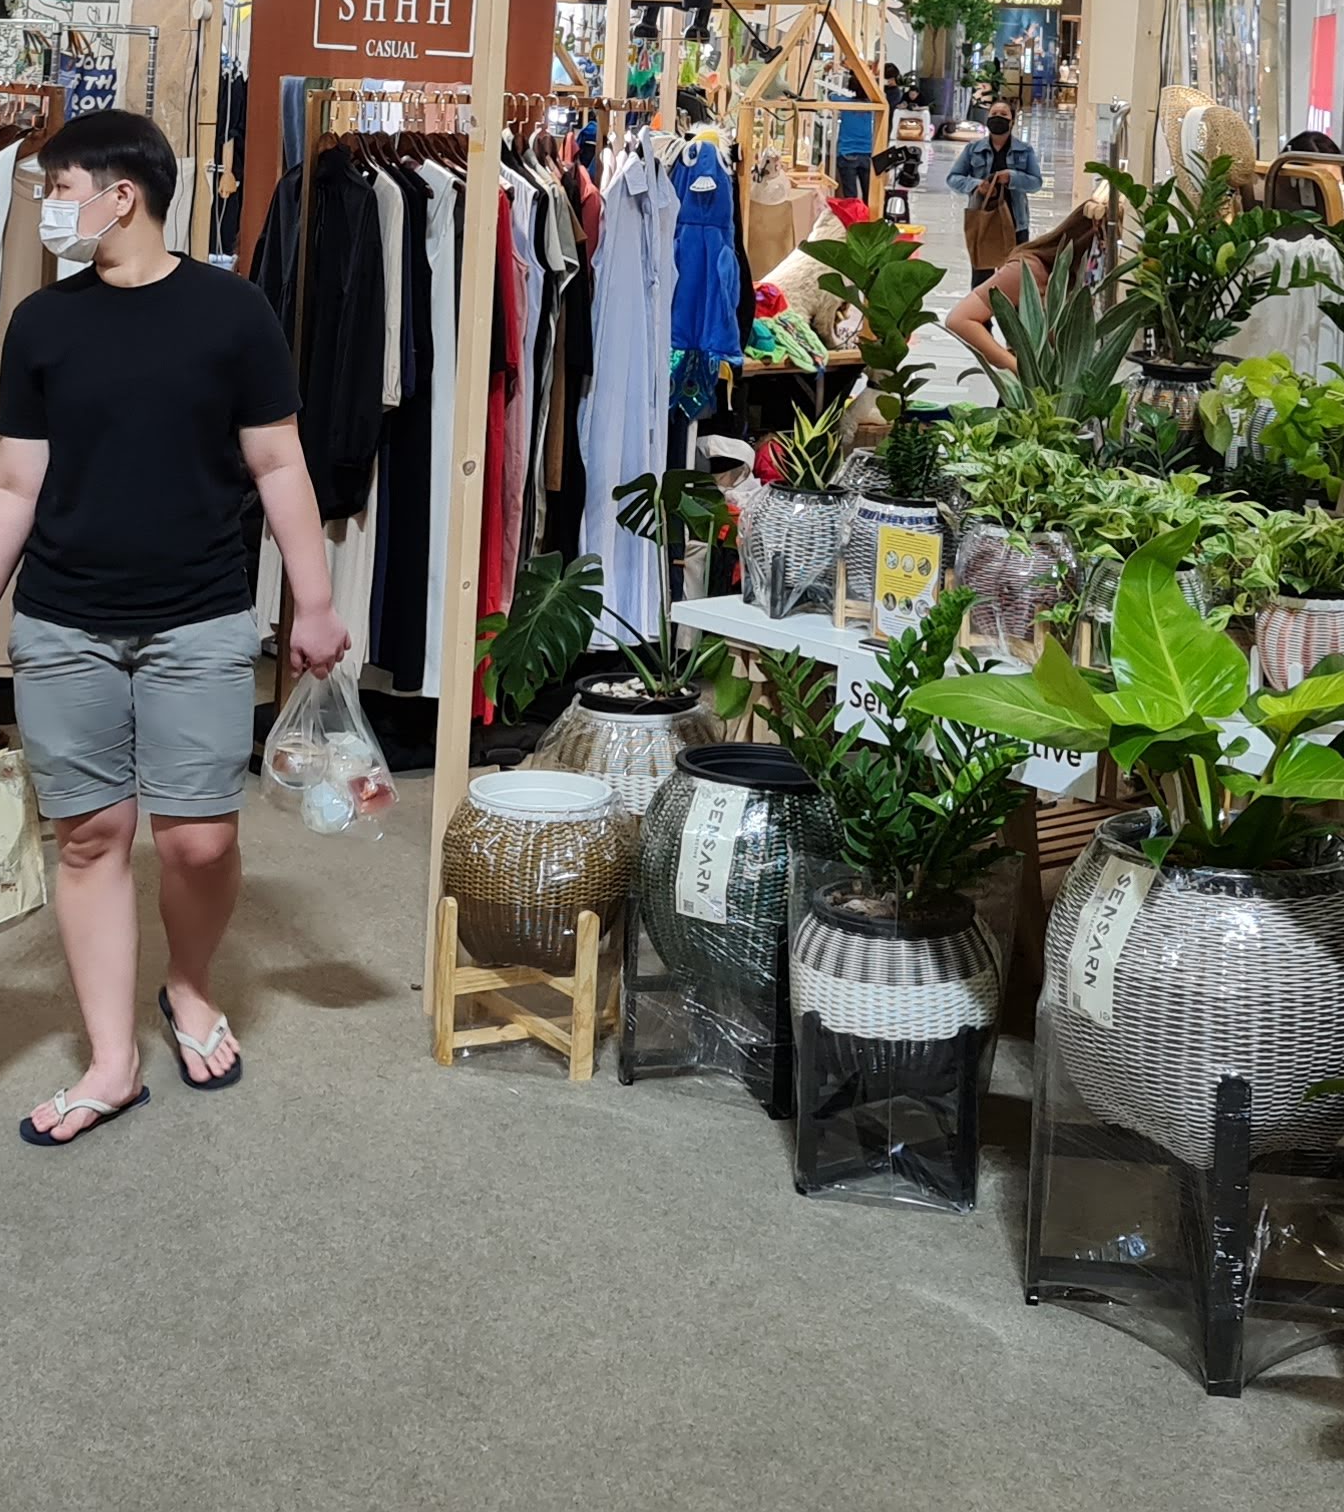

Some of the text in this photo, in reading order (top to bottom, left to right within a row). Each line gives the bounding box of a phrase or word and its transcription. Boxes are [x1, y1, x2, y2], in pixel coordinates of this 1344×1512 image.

[365, 38, 419, 59] CASUAL
[696, 795, 728, 895] SENSARN
[1083, 872, 1133, 990] SENSARN
